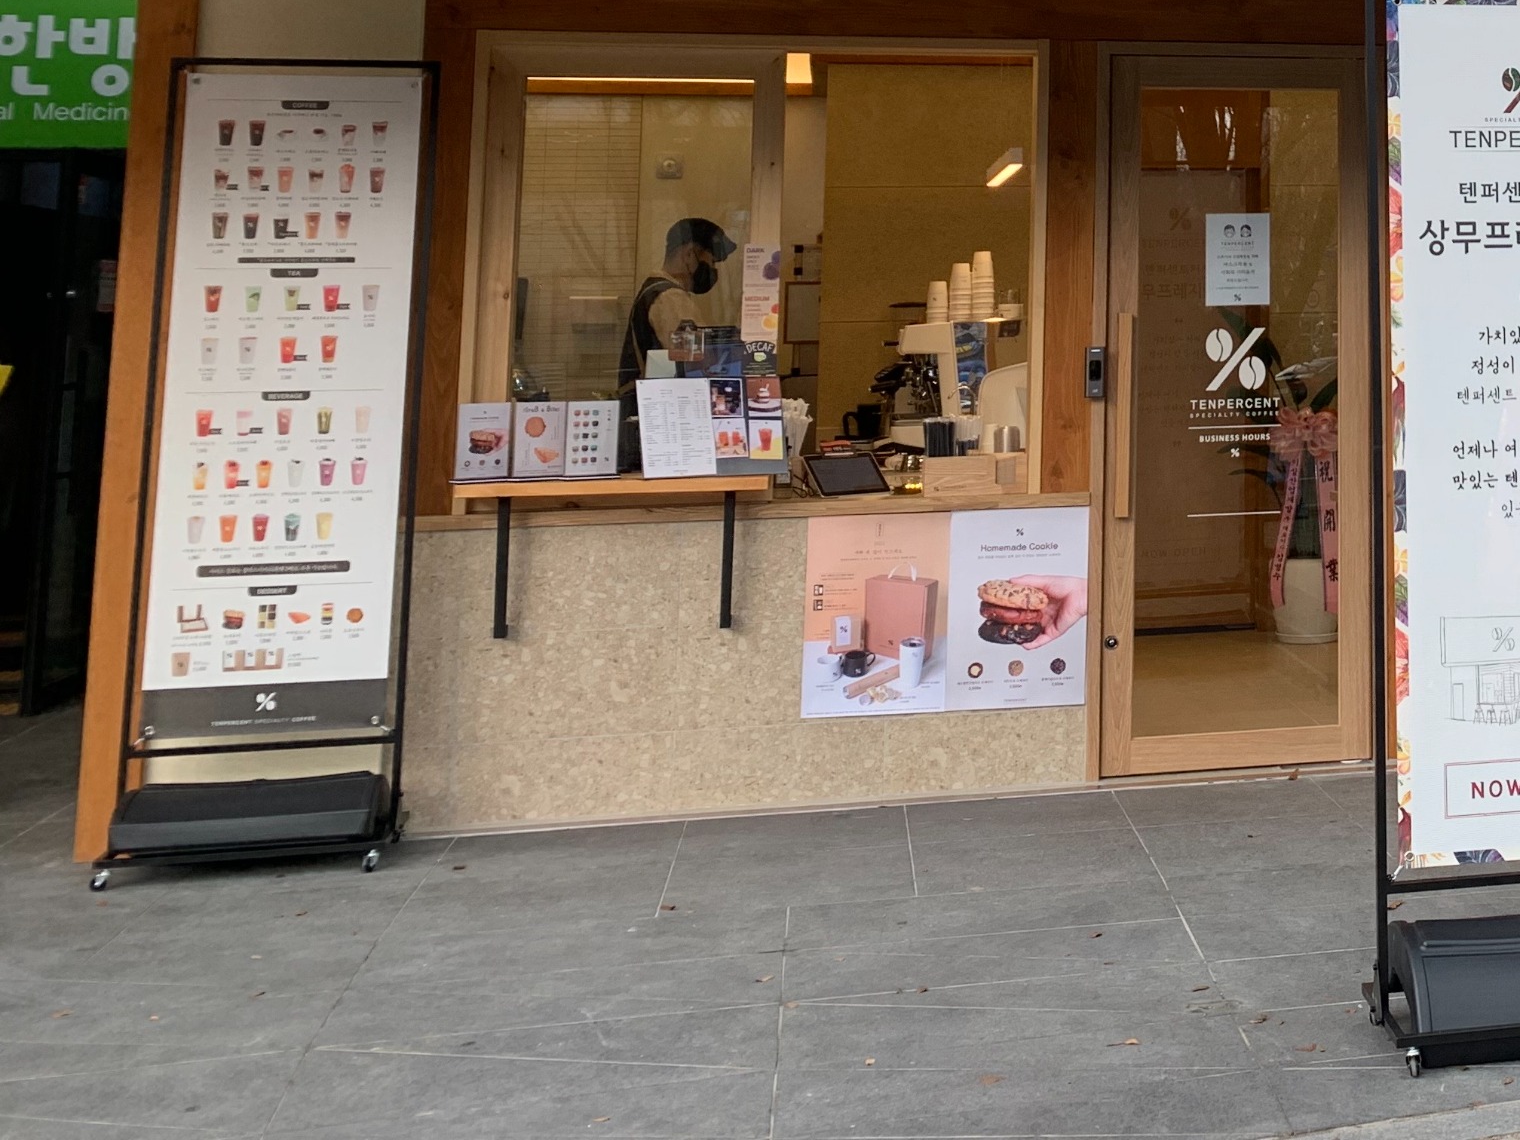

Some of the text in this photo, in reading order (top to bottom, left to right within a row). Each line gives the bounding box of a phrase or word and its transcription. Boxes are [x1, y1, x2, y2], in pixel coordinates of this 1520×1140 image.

[745, 341, 774, 354] DECAF
[1471, 355, 1516, 375] 정성이
[1456, 386, 1518, 406] 텐퍼센트
[1189, 397, 1281, 410] TENPERCENT
[1189, 410, 1280, 419] SPECIALTY COFFEE
[1199, 432, 1271, 443] BUSINESS HOURS
[1452, 438, 1498, 460] 언제나
[1452, 469, 1499, 490] 맛있는
[980, 542, 1059, 552] Homemade Cookie
